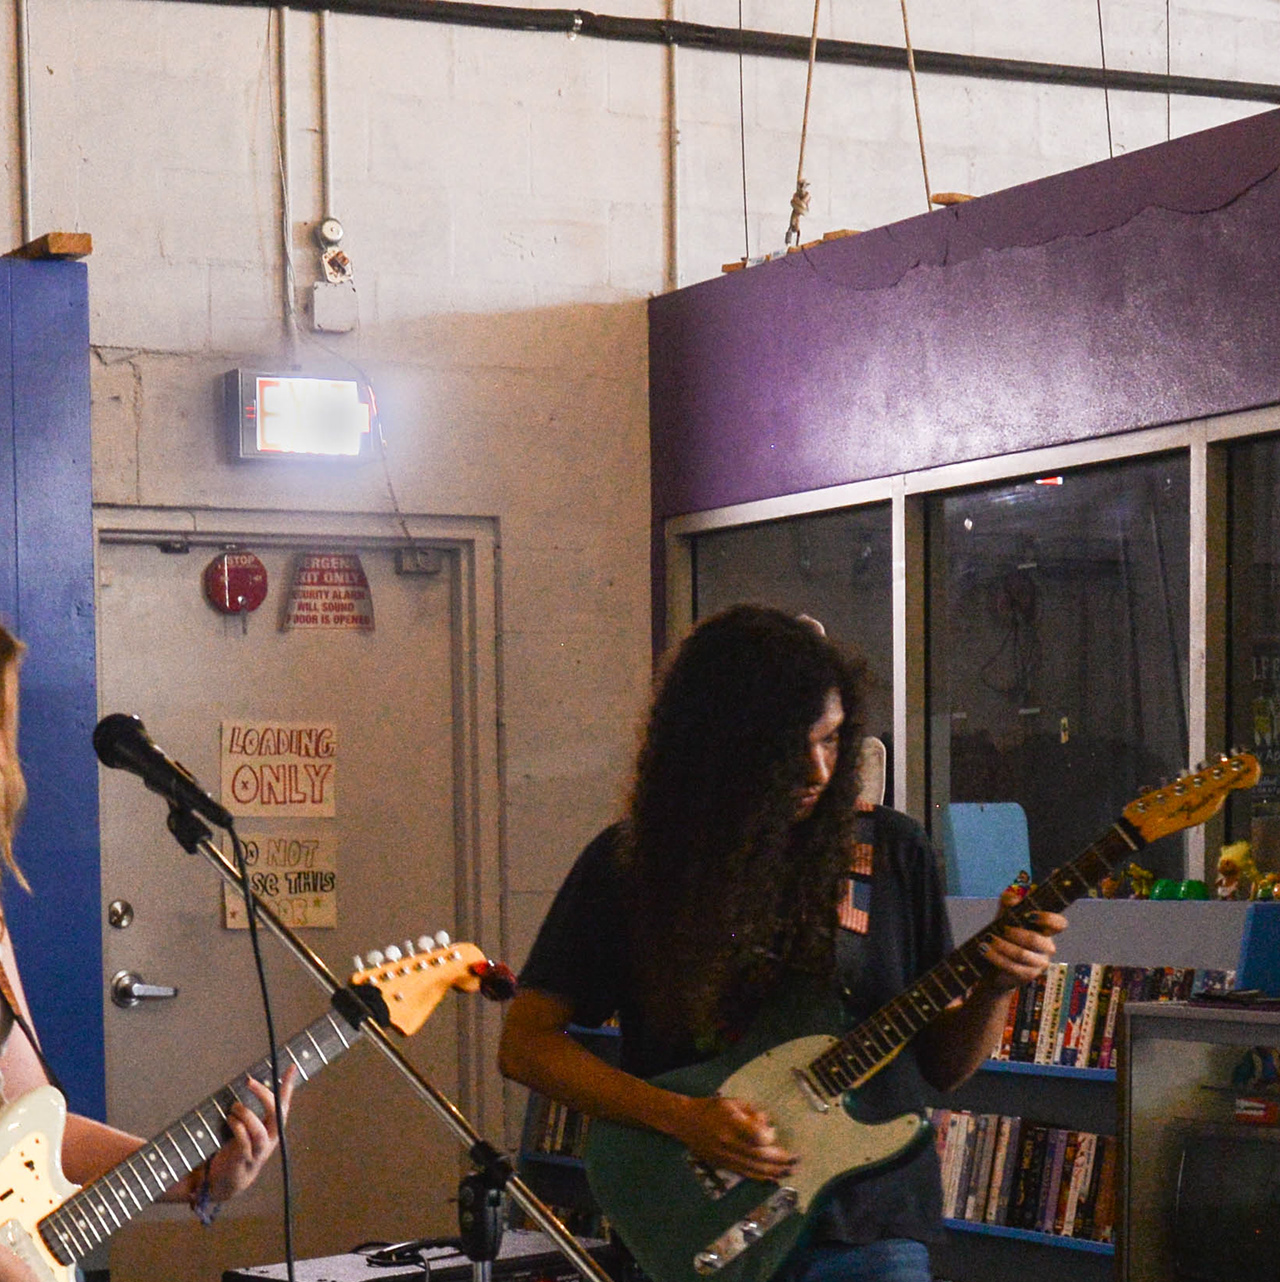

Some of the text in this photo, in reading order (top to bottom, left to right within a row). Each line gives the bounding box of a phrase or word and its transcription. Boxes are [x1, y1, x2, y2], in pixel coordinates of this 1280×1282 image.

[227, 555, 255, 566] STOP
[298, 571, 359, 584] XIT ONLY
[297, 601, 355, 611] WILL SOUND
[321, 614, 330, 624] IS
[229, 726, 337, 759] LOADING
[231, 764, 332, 805] ONLY
[267, 838, 320, 868] NOT
[284, 870, 336, 895] THIS
